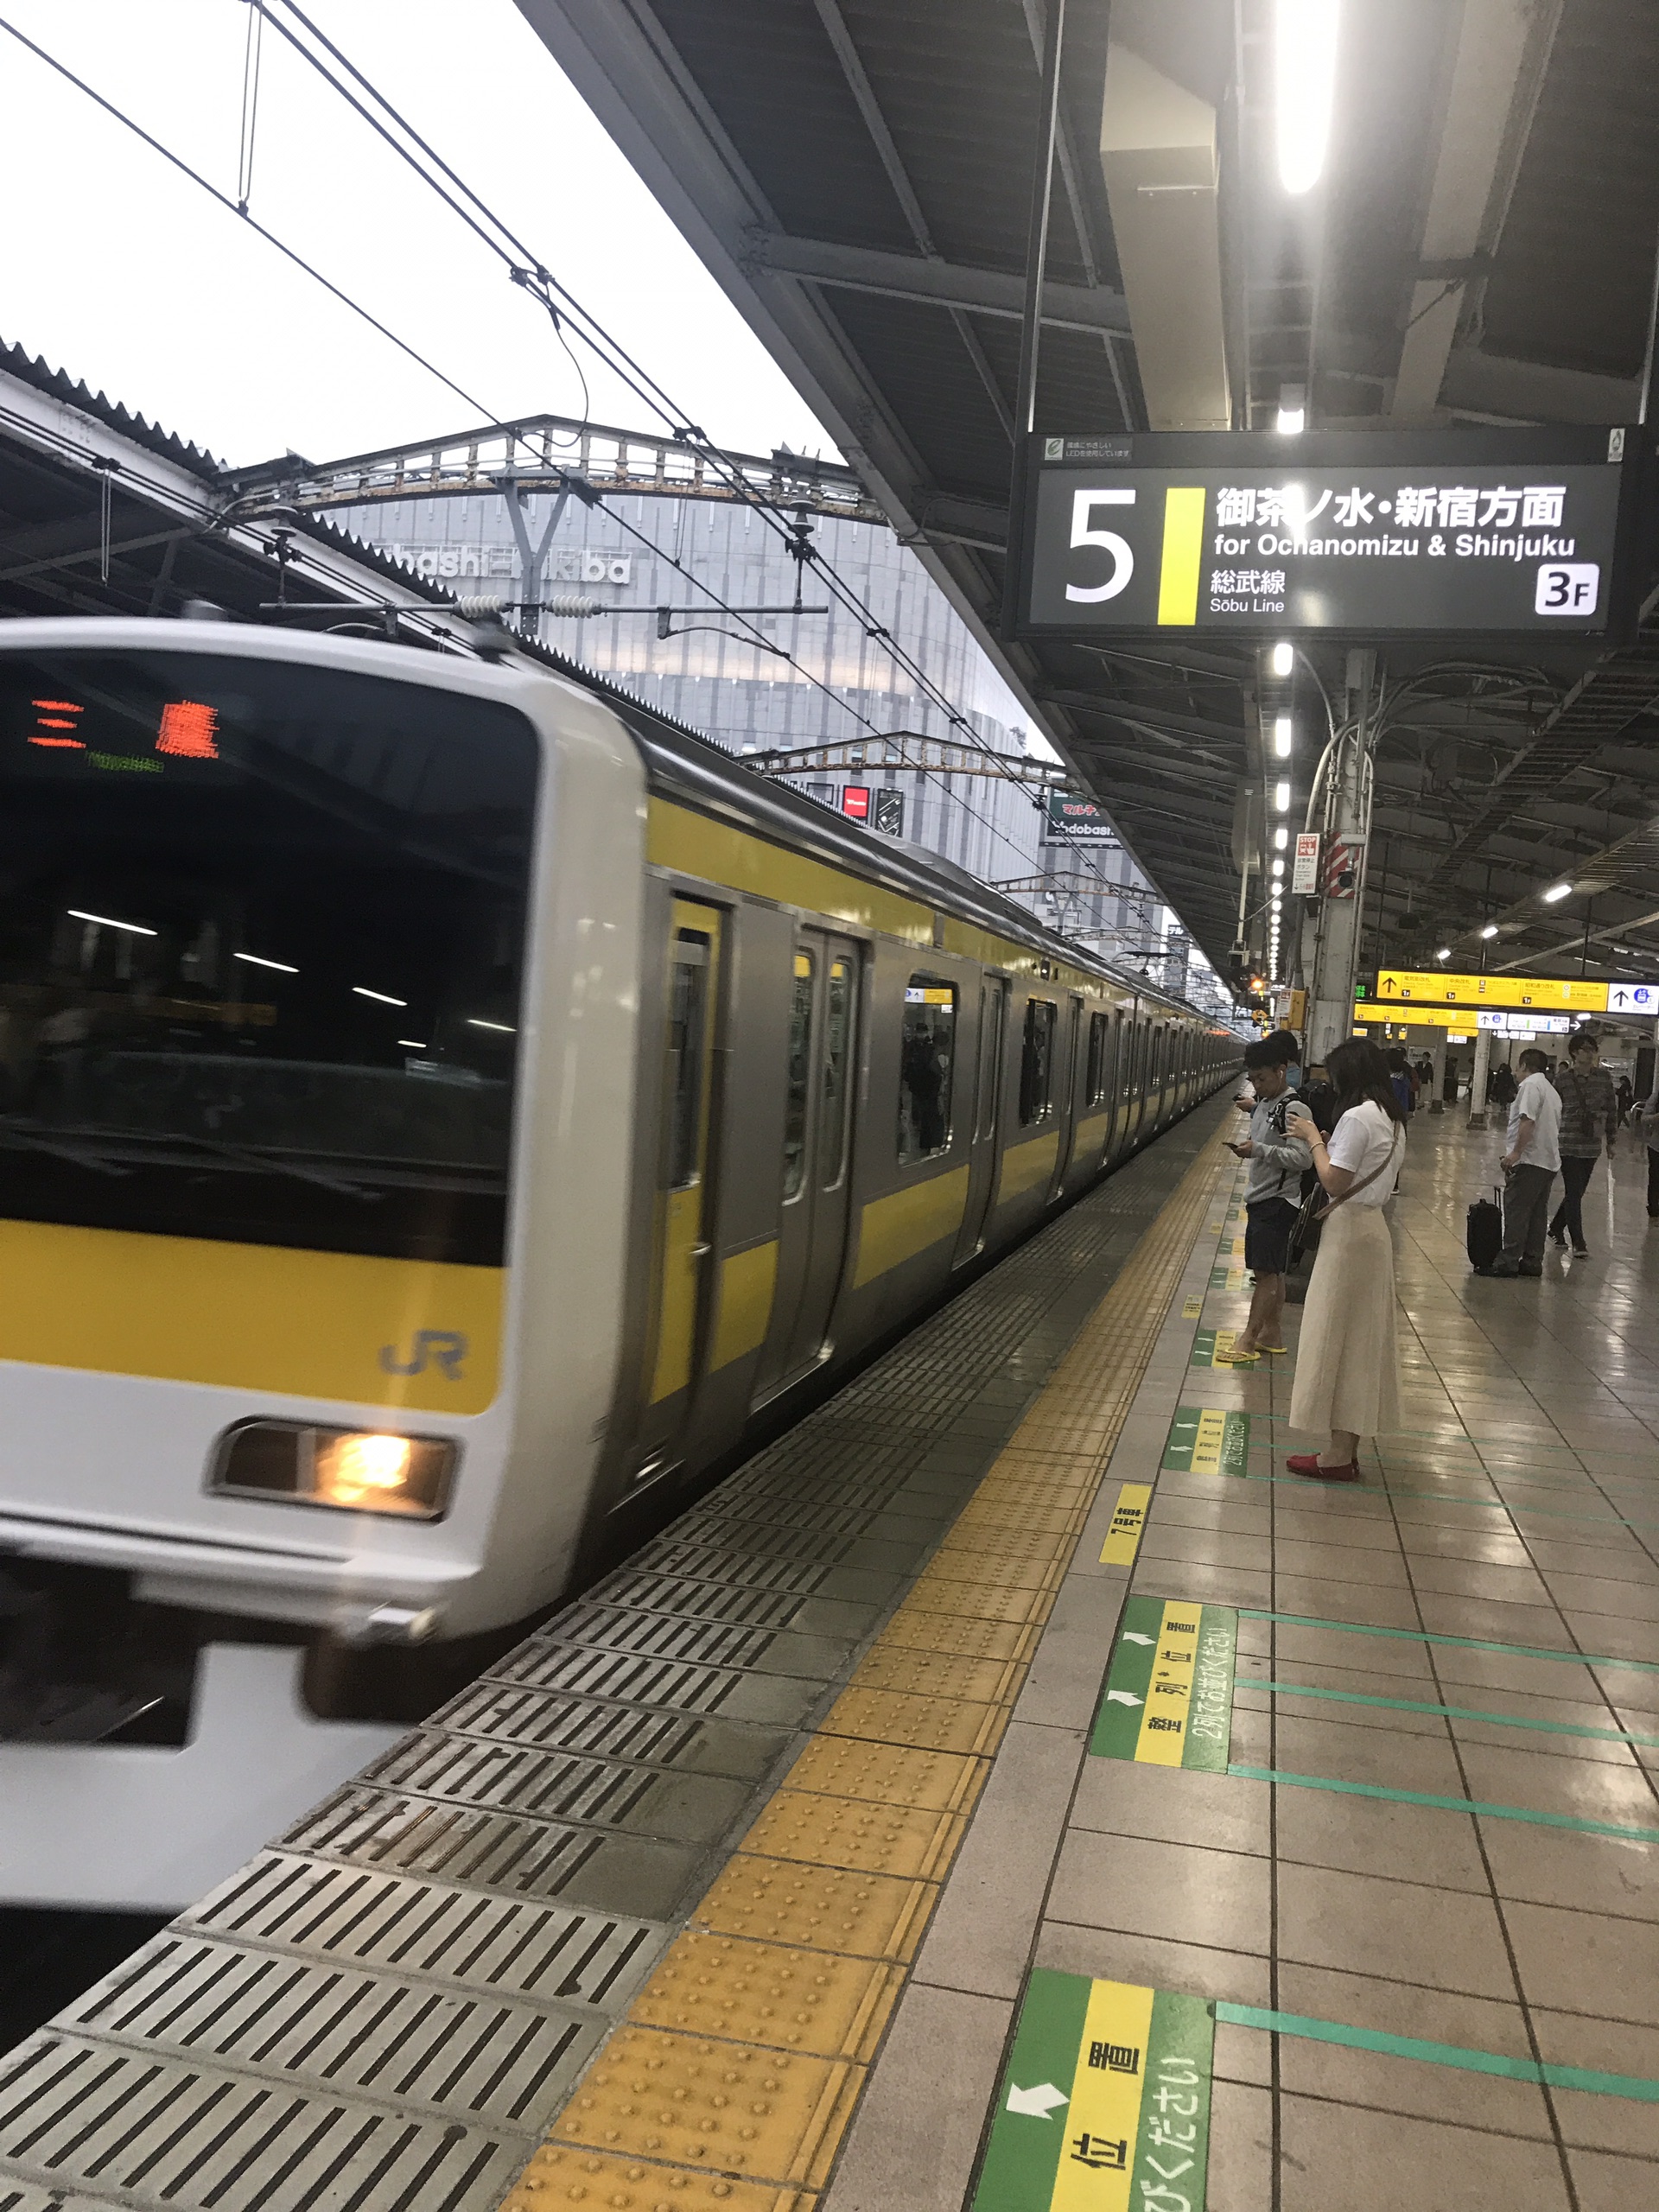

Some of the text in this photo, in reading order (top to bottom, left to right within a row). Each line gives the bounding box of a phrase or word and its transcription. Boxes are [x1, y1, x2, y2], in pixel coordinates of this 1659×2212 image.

[1215, 486, 1567, 527] 御茶ノ水・新宿方面
[1065, 489, 1136, 603] 5
[1214, 533, 1575, 562] for Ochanomizu & Shinjuku
[1210, 569, 1286, 594] 総武線
[1544, 571, 1591, 607] 3F
[1254, 598, 1285, 613] Line
[378, 1329, 468, 1382] JR
[1110, 1507, 1144, 1536] 7号車
[1147, 1621, 1196, 1733] 整列位置
[1192, 1627, 1230, 1740] 2列でお並びください
[1071, 2040, 1141, 2171] 位置
